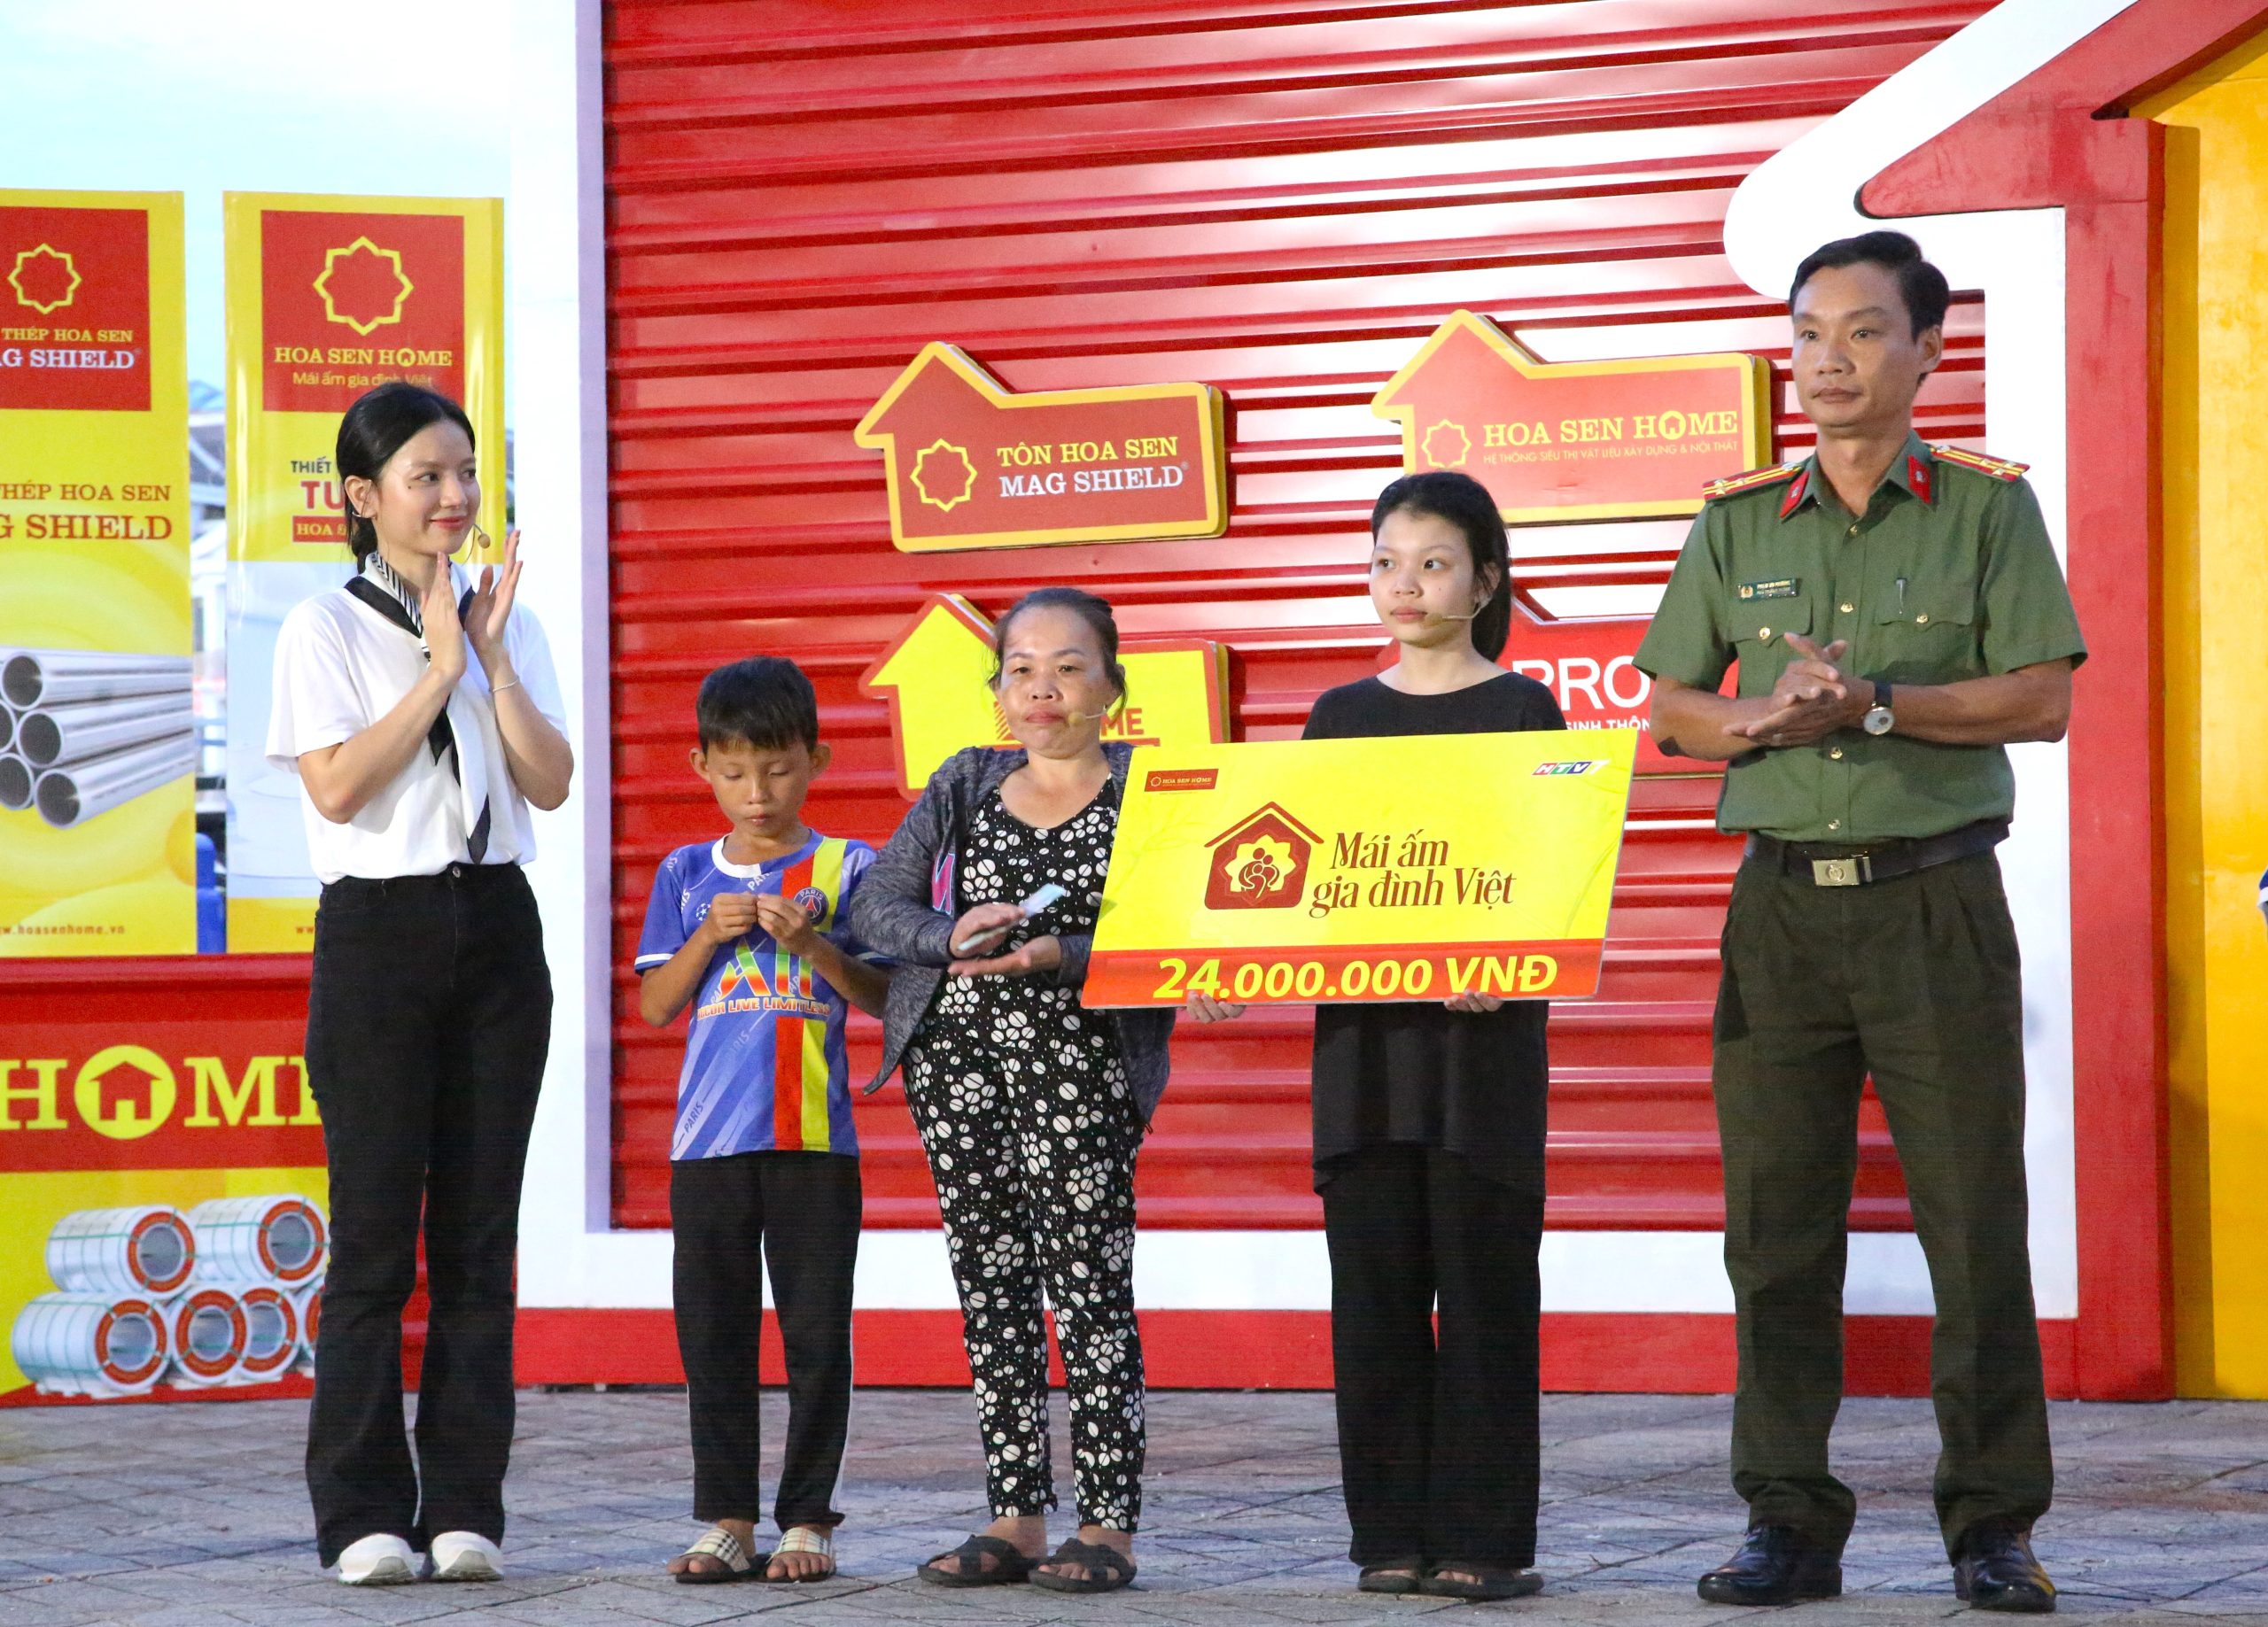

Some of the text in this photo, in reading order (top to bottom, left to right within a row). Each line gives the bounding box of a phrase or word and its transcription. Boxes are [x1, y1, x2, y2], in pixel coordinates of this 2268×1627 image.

[1, 326, 133, 343] THÉP HOA SEN
[0, 348, 135, 368] G SHIELD
[274, 346, 453, 368] HOA SEN HOME
[292, 371, 319, 385] Mái
[347, 373, 369, 388] gia
[1483, 410, 1738, 447] HOA SEN HOME
[997, 437, 1178, 467] TÔN HOA SEN
[291, 456, 332, 474] THIẾT
[0, 479, 171, 502] HÉP HOA SEN
[999, 465, 1184, 498] MAG SHIELD
[26, 515, 172, 540] SHIELD
[297, 523, 333, 537] HOA
[1330, 829, 1449, 869] Mái ấm
[800, 889, 824, 901] PARIS
[1309, 867, 1518, 918] gia đình Việt
[1153, 954, 1558, 998] 24.000.000 VNĐ
[728, 997, 760, 1013] LIVE
[684, 1101, 703, 1134] PARIS
